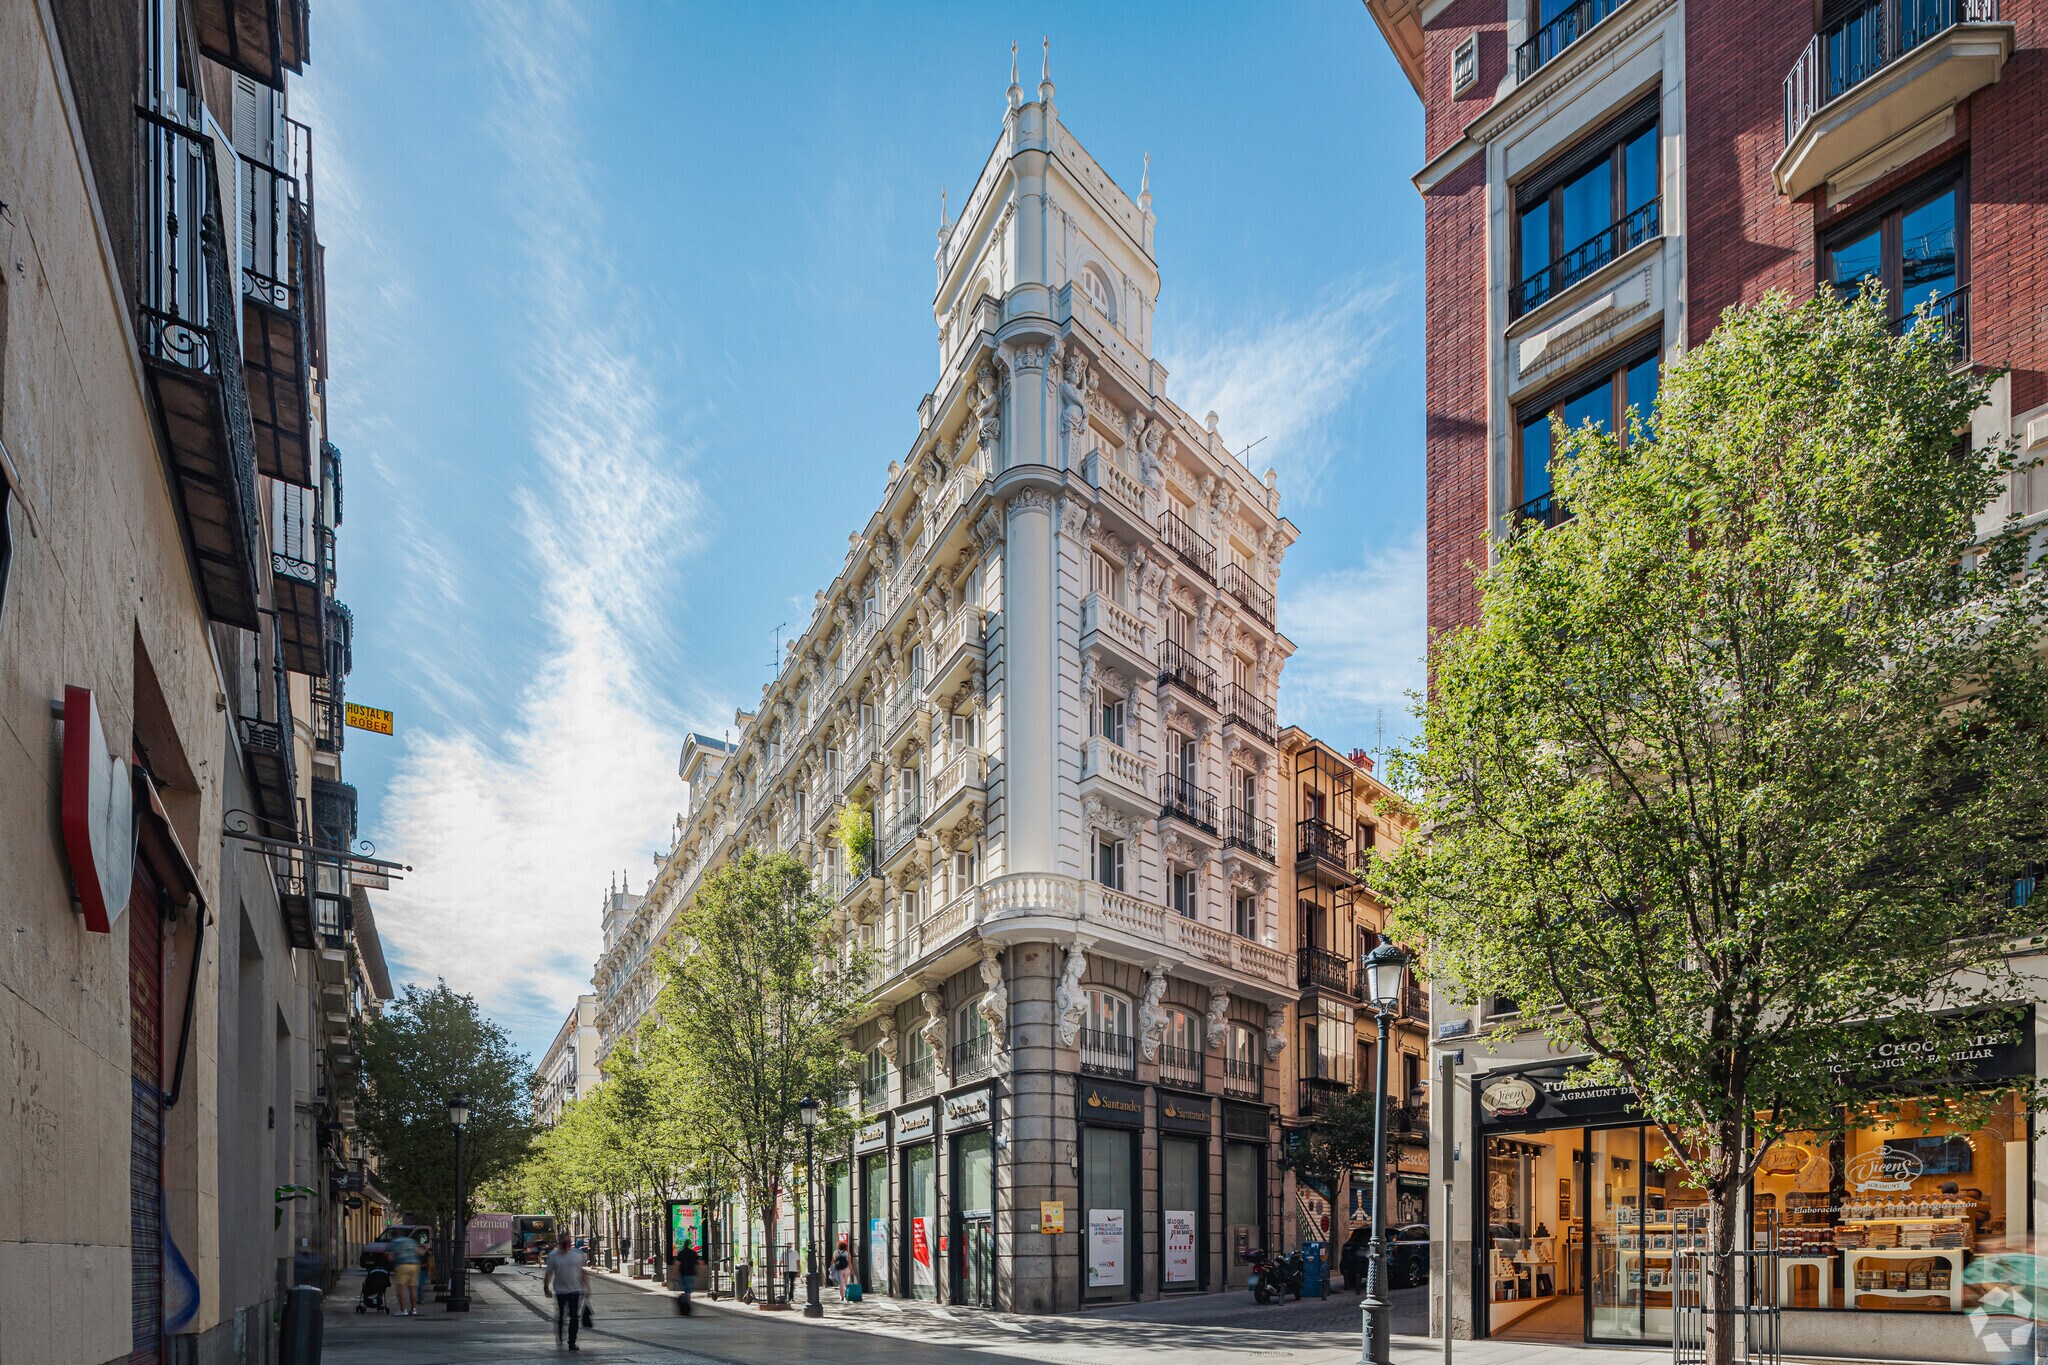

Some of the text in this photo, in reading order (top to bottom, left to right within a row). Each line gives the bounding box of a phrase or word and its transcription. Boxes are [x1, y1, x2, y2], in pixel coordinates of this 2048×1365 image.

[347, 703, 381, 720] HOSTAL
[350, 716, 388, 732] ROBER
[1560, 1088, 1618, 1101] AGRAMUNT
[1102, 1096, 1141, 1113] Santander
[1177, 1107, 1211, 1122] Santander
[1866, 1182, 1901, 1190] AGRAMUNT
[1793, 1205, 1843, 1214] Elaboración
[1921, 1200, 1978, 1210] Degustación
[471, 1218, 508, 1229] guzmán
